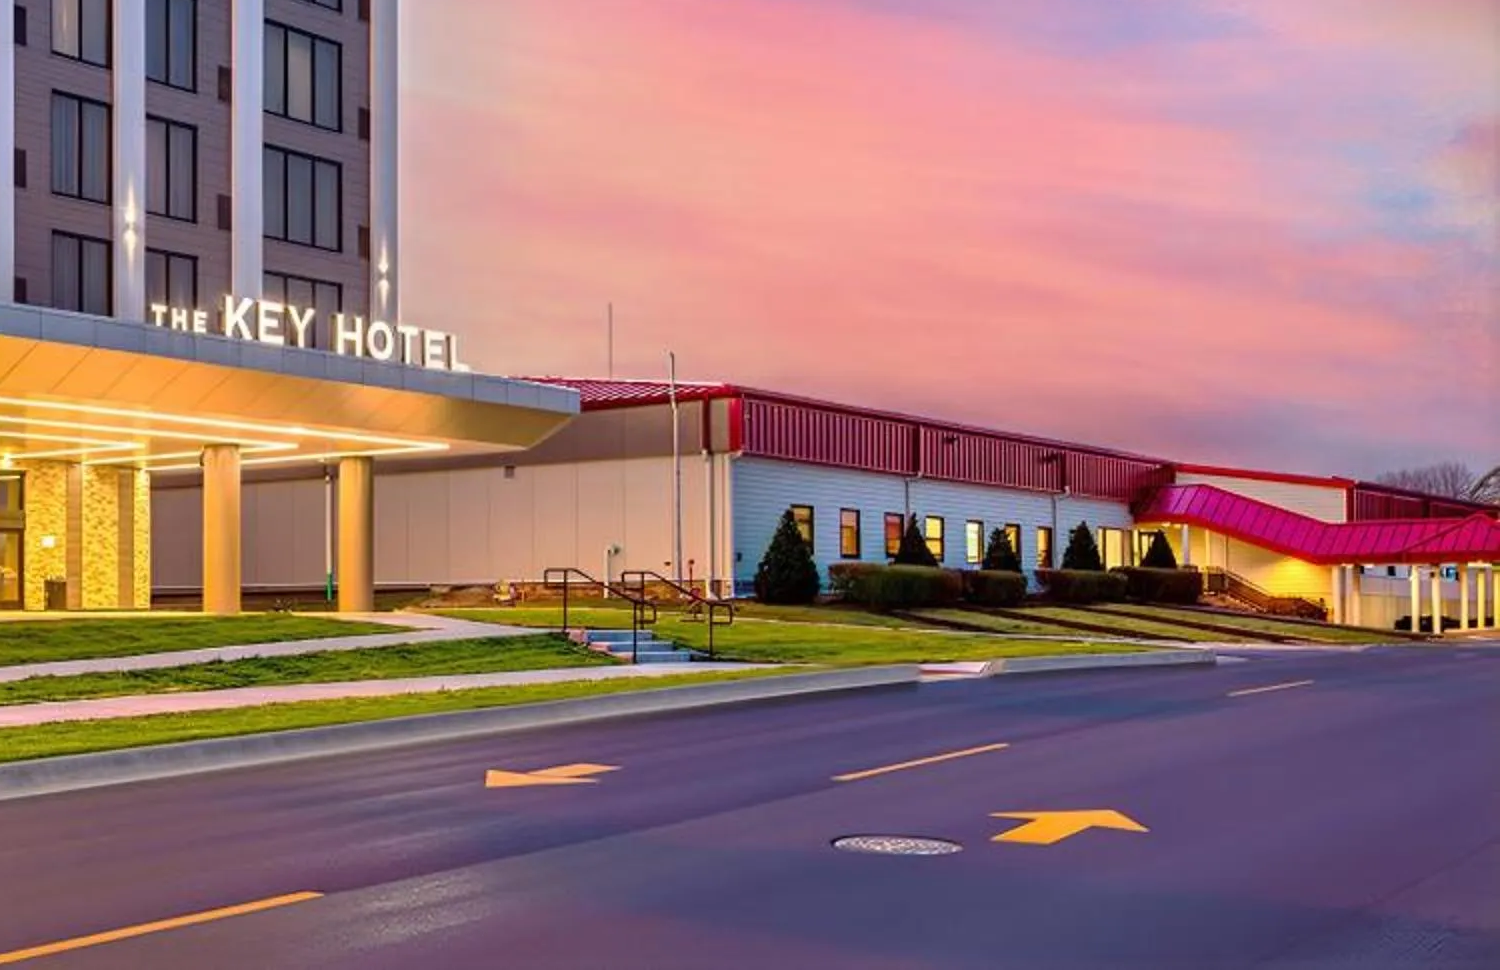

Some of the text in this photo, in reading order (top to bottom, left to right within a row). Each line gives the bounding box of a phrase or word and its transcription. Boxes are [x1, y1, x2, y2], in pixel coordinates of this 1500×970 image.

[151, 294, 471, 372] THE KEY HOTEL
